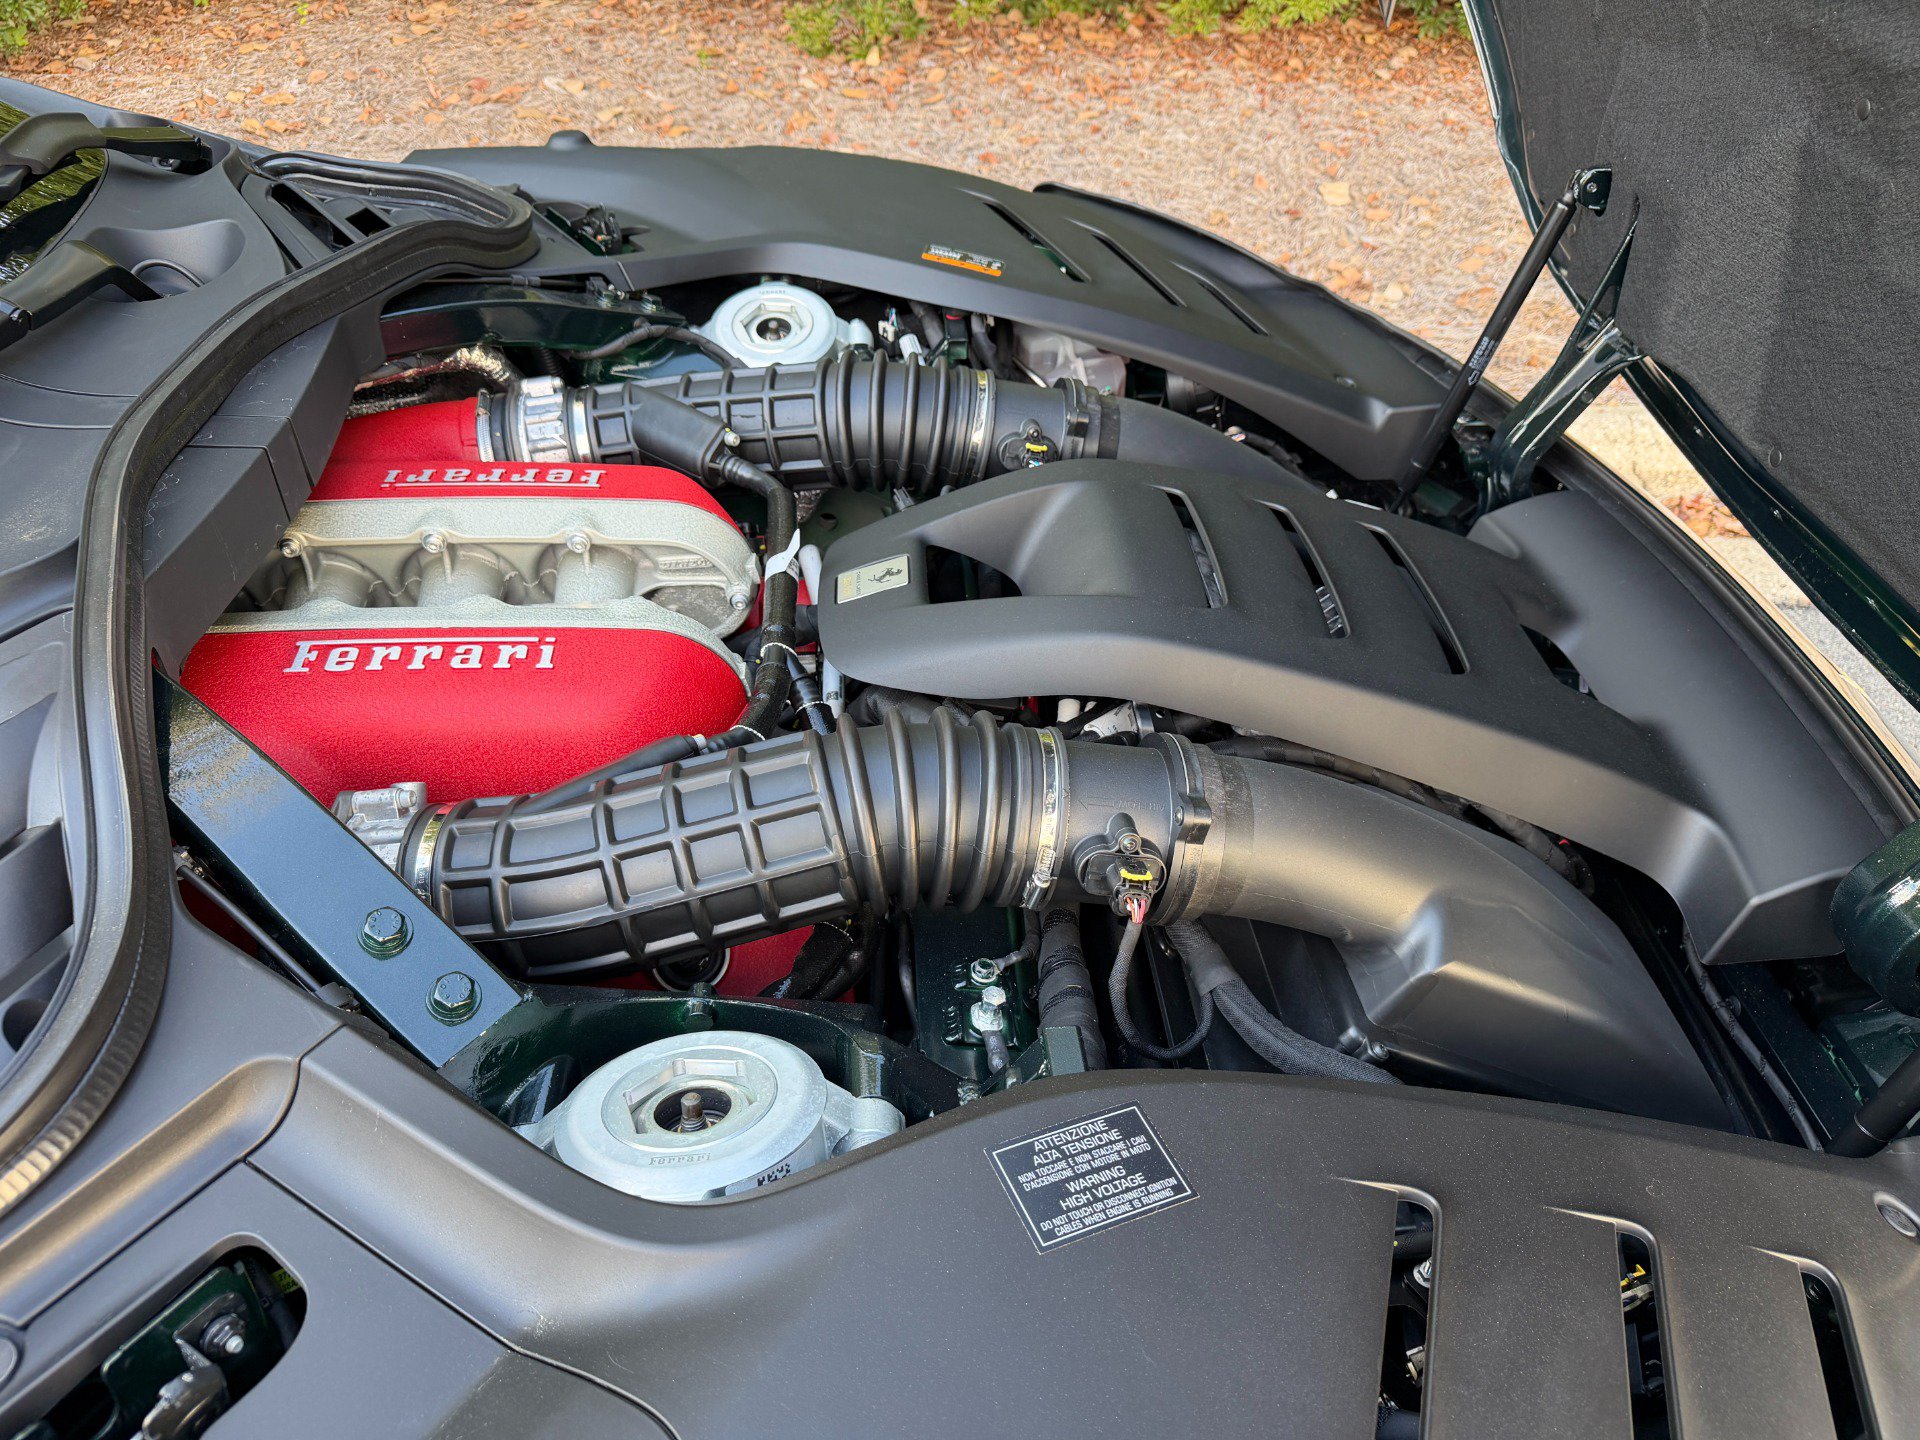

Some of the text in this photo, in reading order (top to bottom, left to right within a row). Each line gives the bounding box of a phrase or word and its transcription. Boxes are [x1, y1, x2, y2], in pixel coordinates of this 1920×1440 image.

[380, 468, 606, 489] Ferrari
[283, 637, 556, 673] Ferrari
[1033, 1128, 1122, 1166] ALTA TENSIONE
[1034, 1120, 1108, 1152] ATTENZIONE
[649, 1152, 712, 1166] Ferrari
[1018, 1171, 1036, 1183] NON
[1035, 1160, 1069, 1176] TOCCARE
[1068, 1158, 1075, 1166] E
[1074, 1152, 1092, 1164] NON
[1091, 1141, 1126, 1158] STACCARE
[1130, 1135, 1146, 1145] CAVI
[1023, 1143, 1151, 1191] D'ACCENSIONE CON MOTORE IN MOTO
[1059, 1172, 1147, 1210] HIGH VOLTAGE
[1065, 1165, 1126, 1192] WARNING
[1040, 1176, 1177, 1231] DO NOT TOUCH OR DISCONNECT IGNITION
[1054, 1188, 1174, 1236] CABLES WHEN ENGINE IS RUNNING
